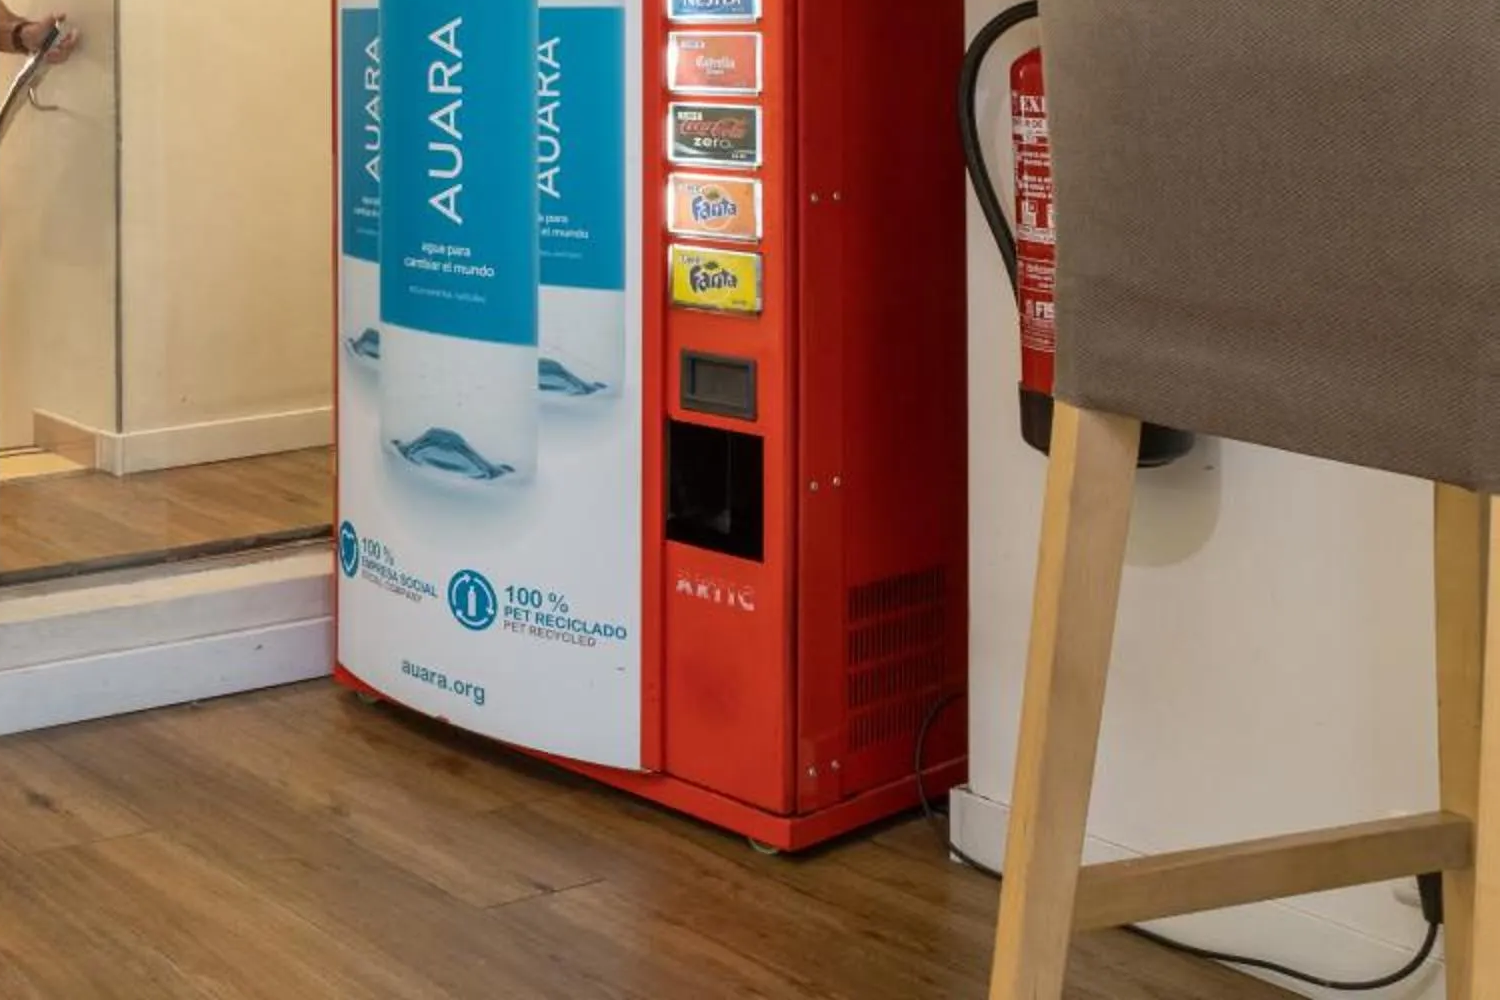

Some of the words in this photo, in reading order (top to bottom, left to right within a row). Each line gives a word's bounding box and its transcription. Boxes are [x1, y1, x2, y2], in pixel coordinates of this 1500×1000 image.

[364, 37, 380, 182] AUARA
[428, 16, 463, 226] AUARA
[537, 35, 561, 198] AUARA
[693, 136, 731, 149] zero
[691, 195, 737, 221] Fanta
[447, 245, 471, 259] para
[453, 264, 495, 278] mundo
[689, 266, 737, 293] Fanta
[362, 537, 380, 560] 100
[399, 572, 438, 598] SOCIAL
[505, 584, 542, 609] 100
[548, 590, 569, 614] %
[503, 619, 526, 634] PET
[529, 624, 596, 648] RECYCLED
[504, 605, 531, 623] PET
[534, 612, 627, 640] RECICLADO
[402, 659, 485, 706] auara.org
